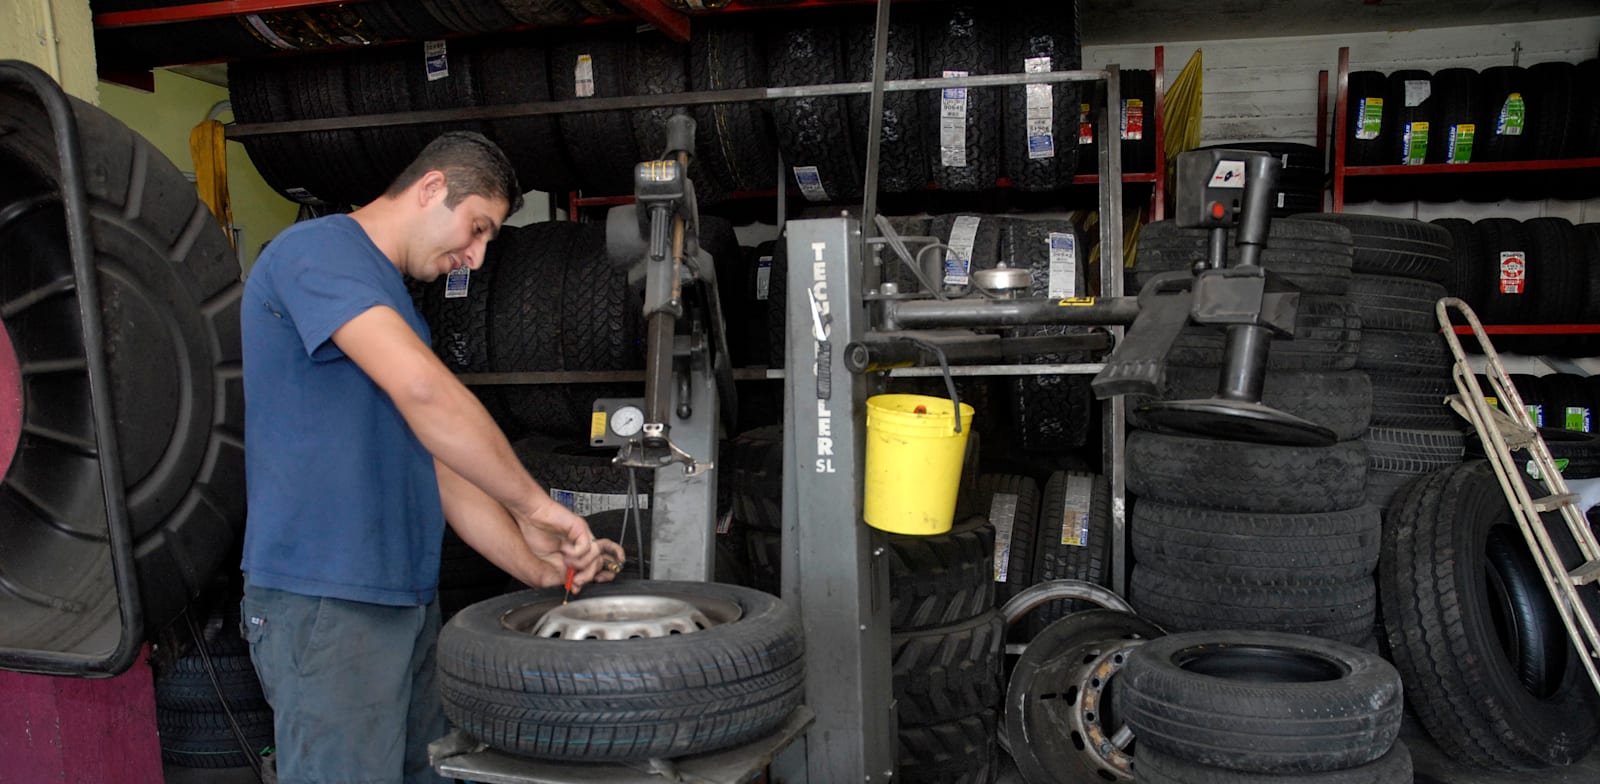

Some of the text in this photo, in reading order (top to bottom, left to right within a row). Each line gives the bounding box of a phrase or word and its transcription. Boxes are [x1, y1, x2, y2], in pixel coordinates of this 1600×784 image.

[1403, 124, 1412, 156] MICLIN
[1447, 126, 1457, 158] MICHELIN
[811, 241, 834, 456] TECNOLER
[815, 458, 836, 473] SL
